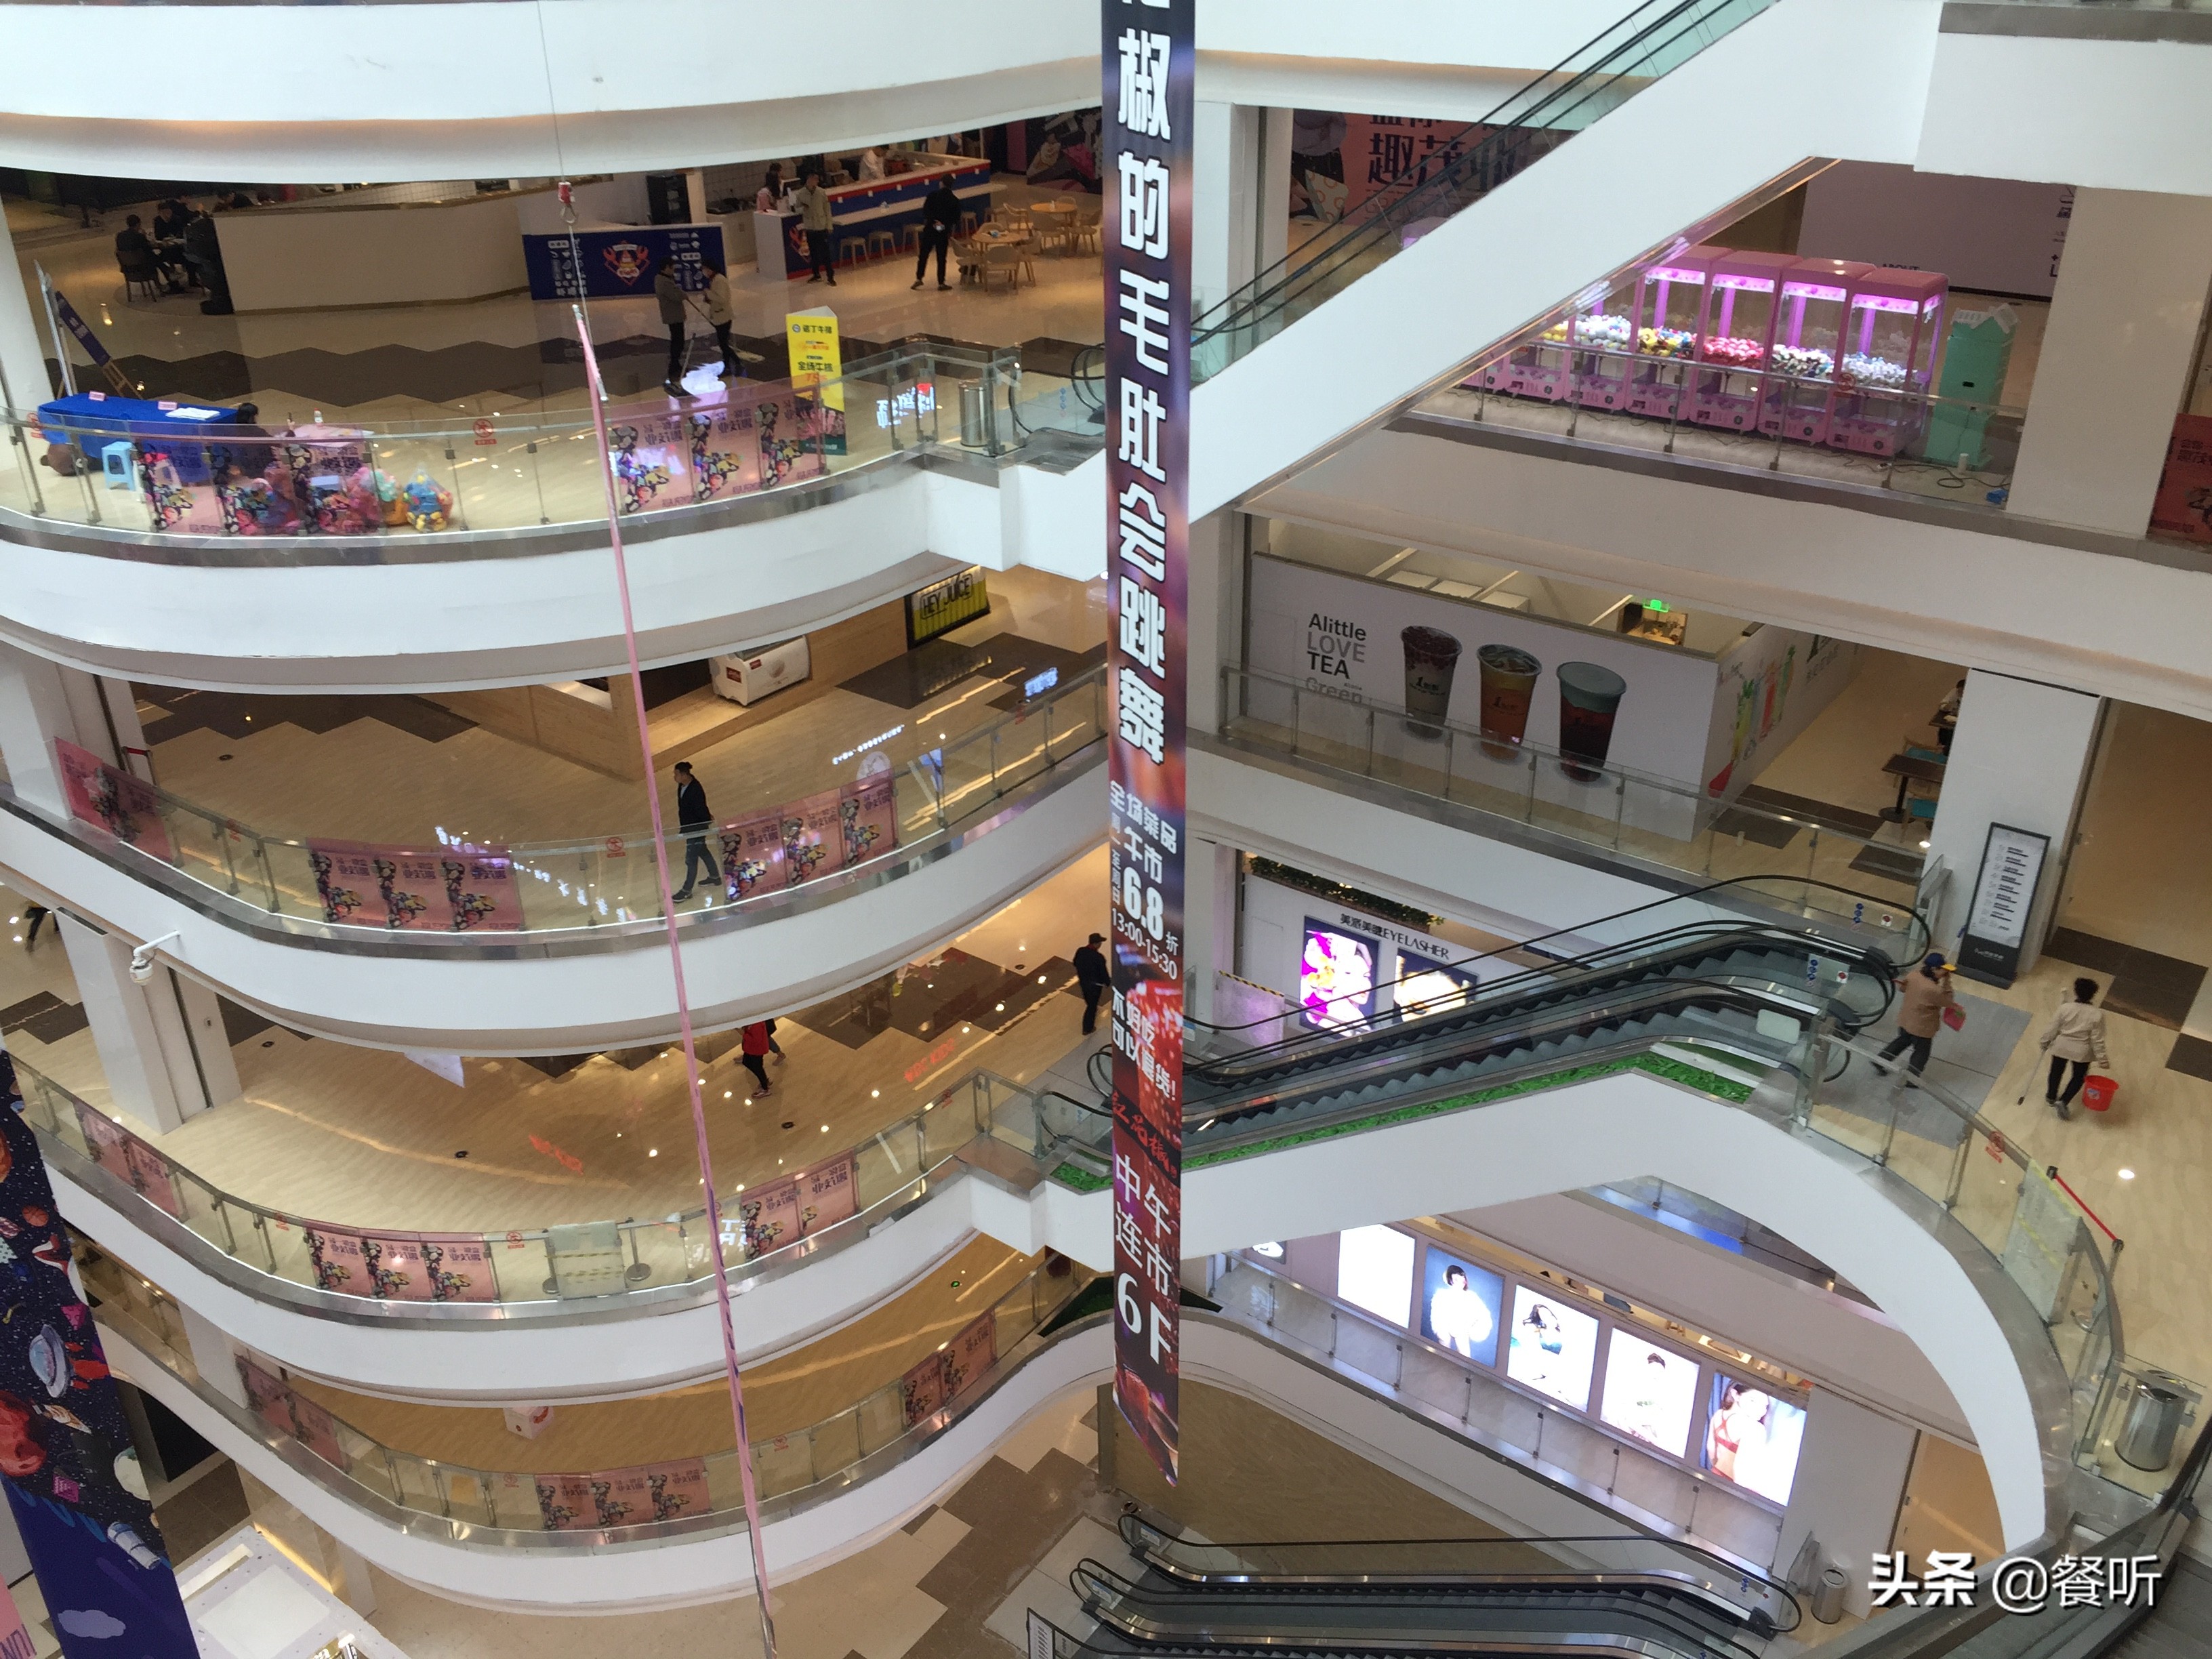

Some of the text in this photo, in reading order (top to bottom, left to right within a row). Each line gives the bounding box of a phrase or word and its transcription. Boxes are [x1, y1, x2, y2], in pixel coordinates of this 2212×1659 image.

[1117, 0, 1172, 765] 椒的毛肚会跳舞
[923, 575, 970, 616] HEY JUICE
[1307, 631, 1366, 663] LOVE
[1309, 613, 1367, 641] Alittle
[1307, 651, 1350, 679] TEA
[1110, 780, 1177, 855] 全场菜品
[1124, 825, 1164, 884] 午市
[1111, 907, 1178, 981] 13:00-15:30
[1118, 1271, 1172, 1365] 6F
